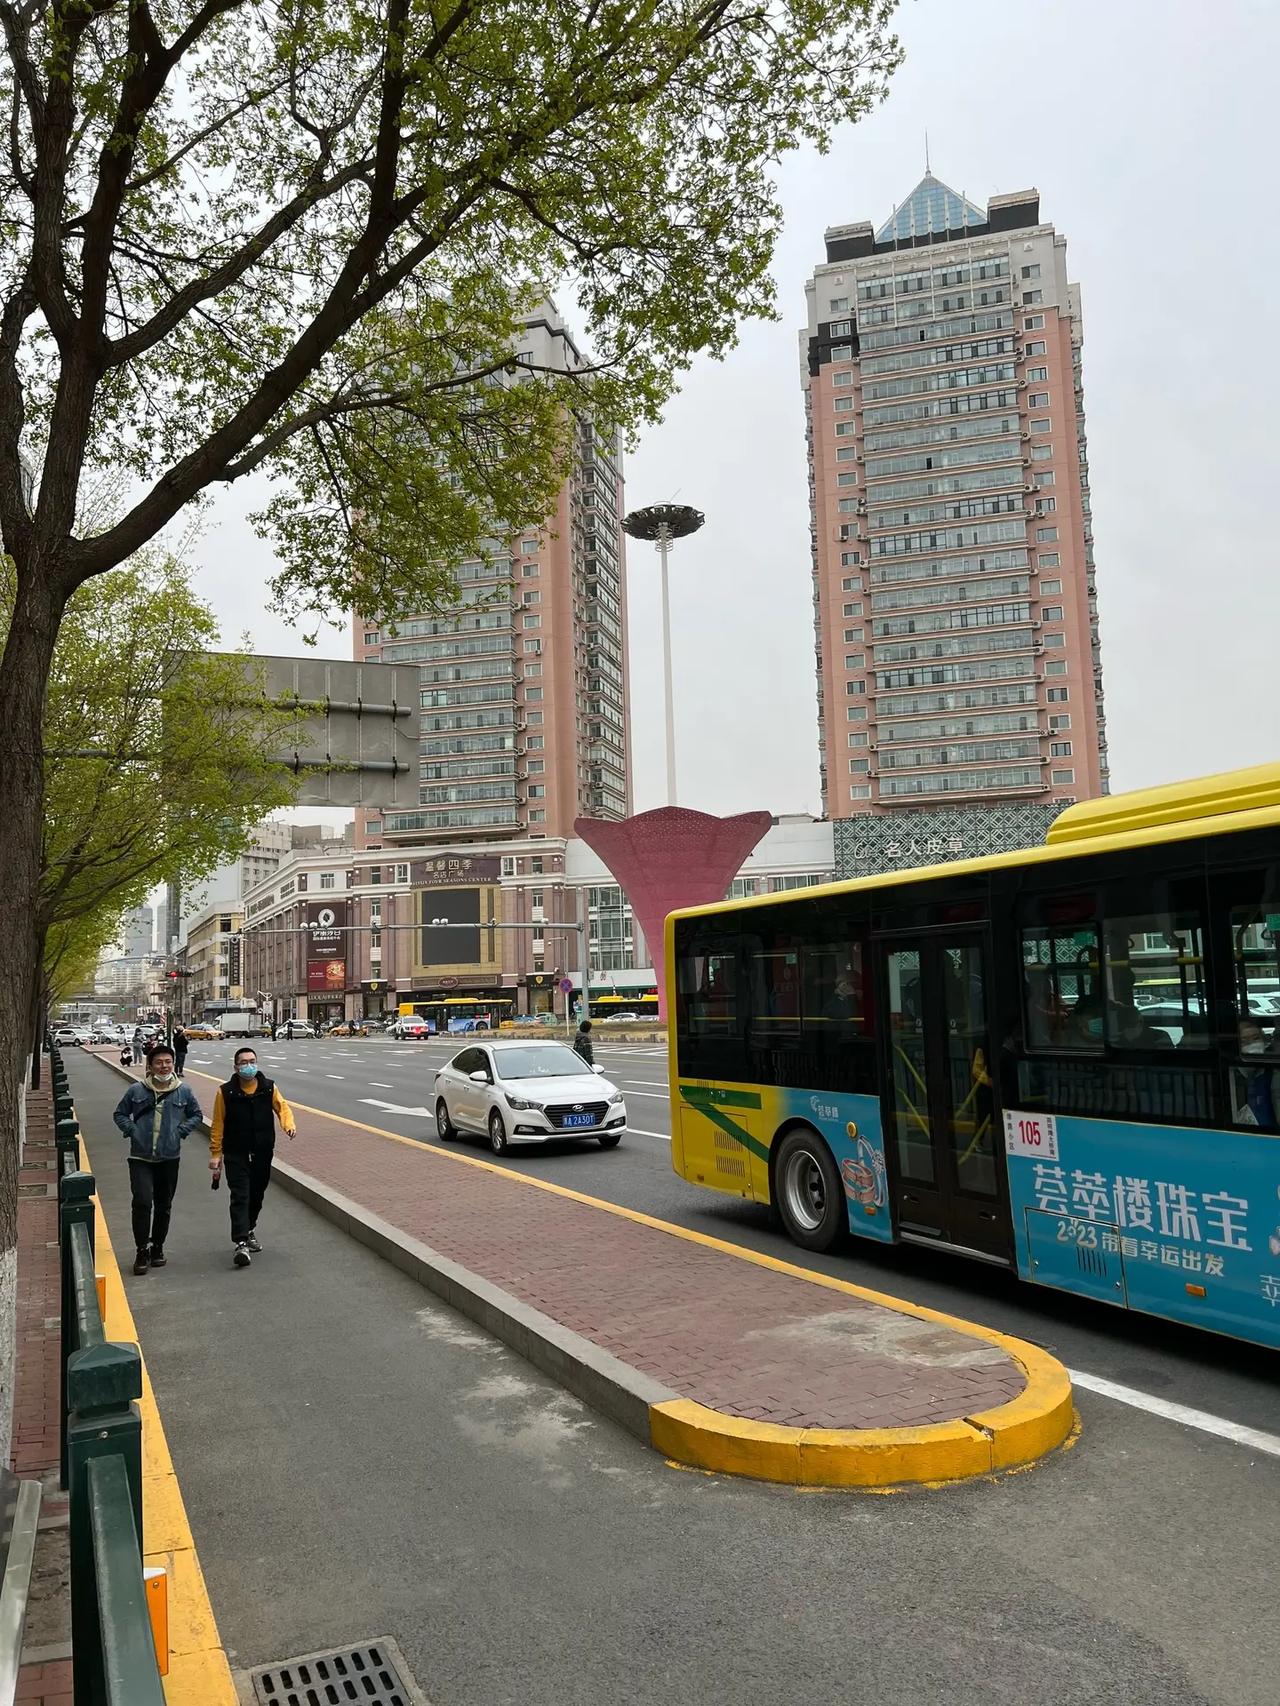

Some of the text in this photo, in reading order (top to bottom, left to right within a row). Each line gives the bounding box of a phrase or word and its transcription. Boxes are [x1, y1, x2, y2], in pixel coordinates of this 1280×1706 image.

[885, 838, 964, 858] 名人皮草
[1018, 1120, 1041, 1146] 105
[1032, 1163, 1252, 1251] 荟萃楼珠宝
